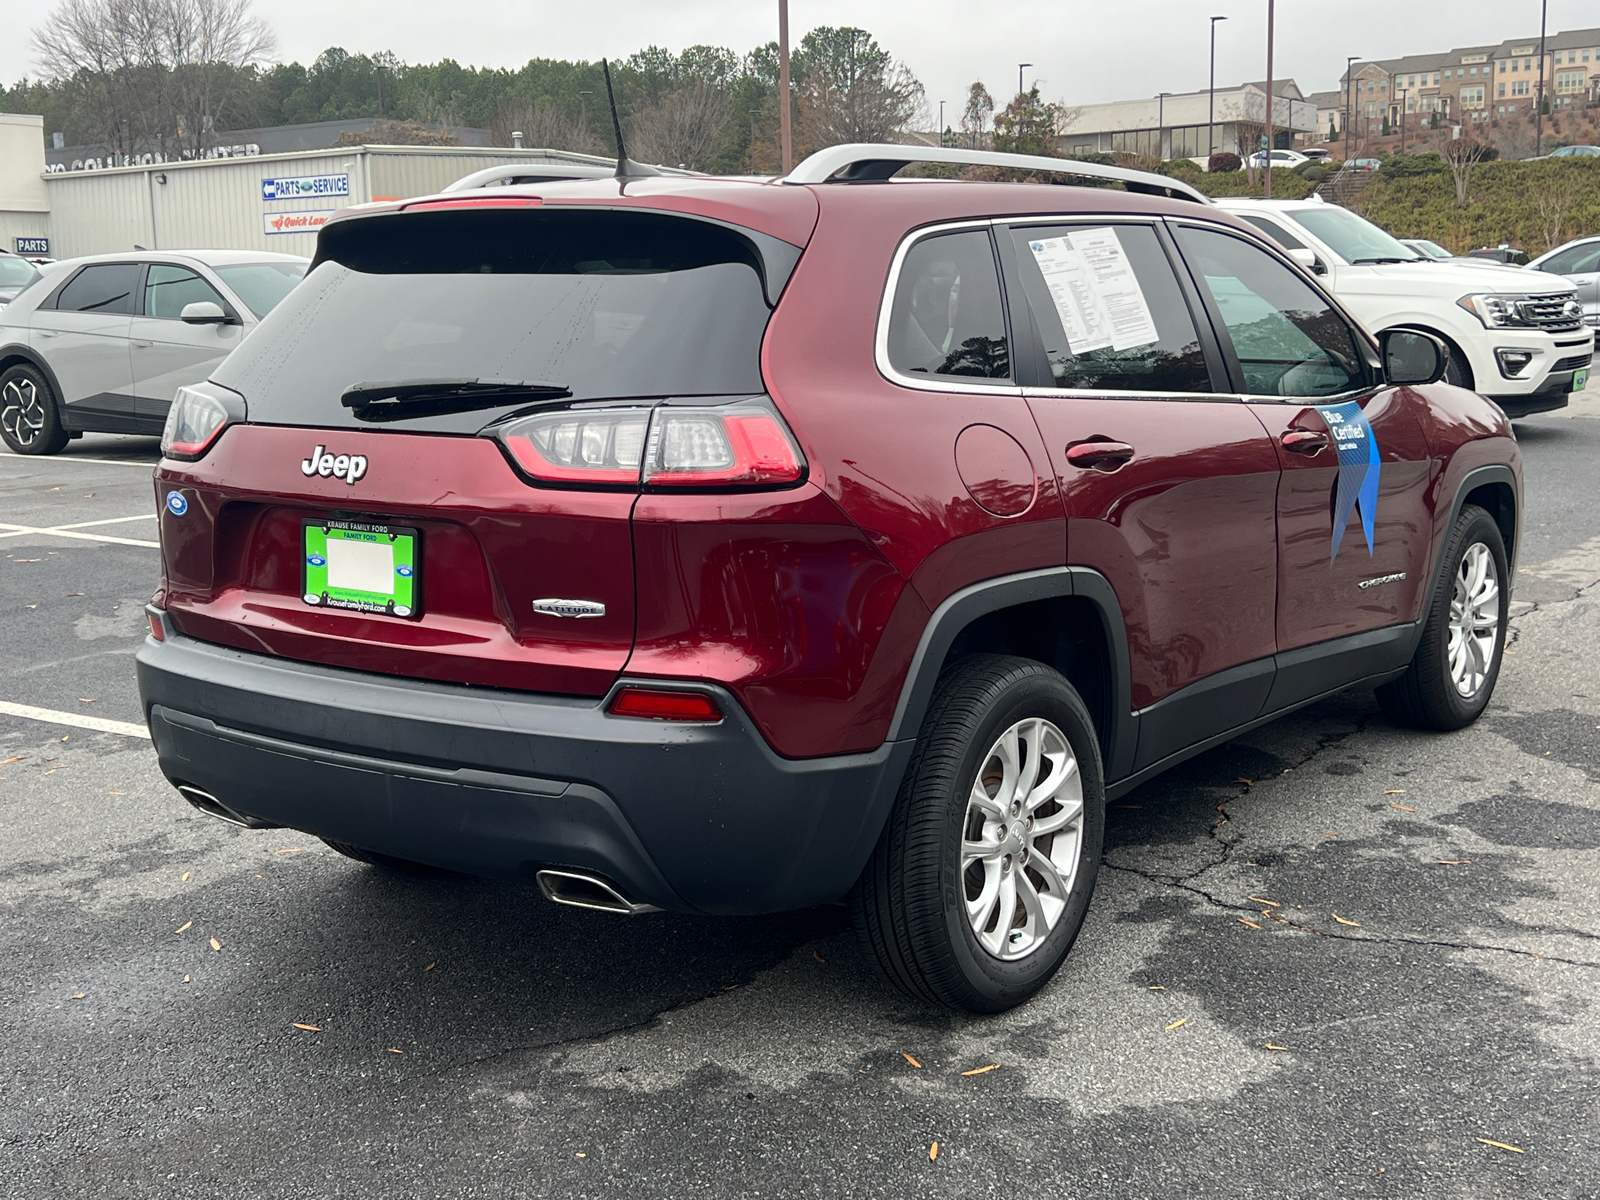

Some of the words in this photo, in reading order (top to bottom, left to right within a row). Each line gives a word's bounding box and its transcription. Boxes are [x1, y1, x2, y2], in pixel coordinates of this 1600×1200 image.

[275, 181, 300, 195] PARTS
[313, 177, 347, 193] SERVICE
[284, 216, 307, 228] Quick
[18, 240, 47, 251] PARTS
[1322, 410, 1345, 424] Blue
[1332, 424, 1365, 440] Certified
[302, 444, 368, 485] Jeep
[327, 519, 349, 529] KRAUSE
[350, 522, 370, 531] FAMILY
[371, 525, 388, 533] FORD
[343, 531, 361, 540] FAMILY
[363, 533, 377, 542] FORD
[539, 605, 596, 613] LATITUDE
